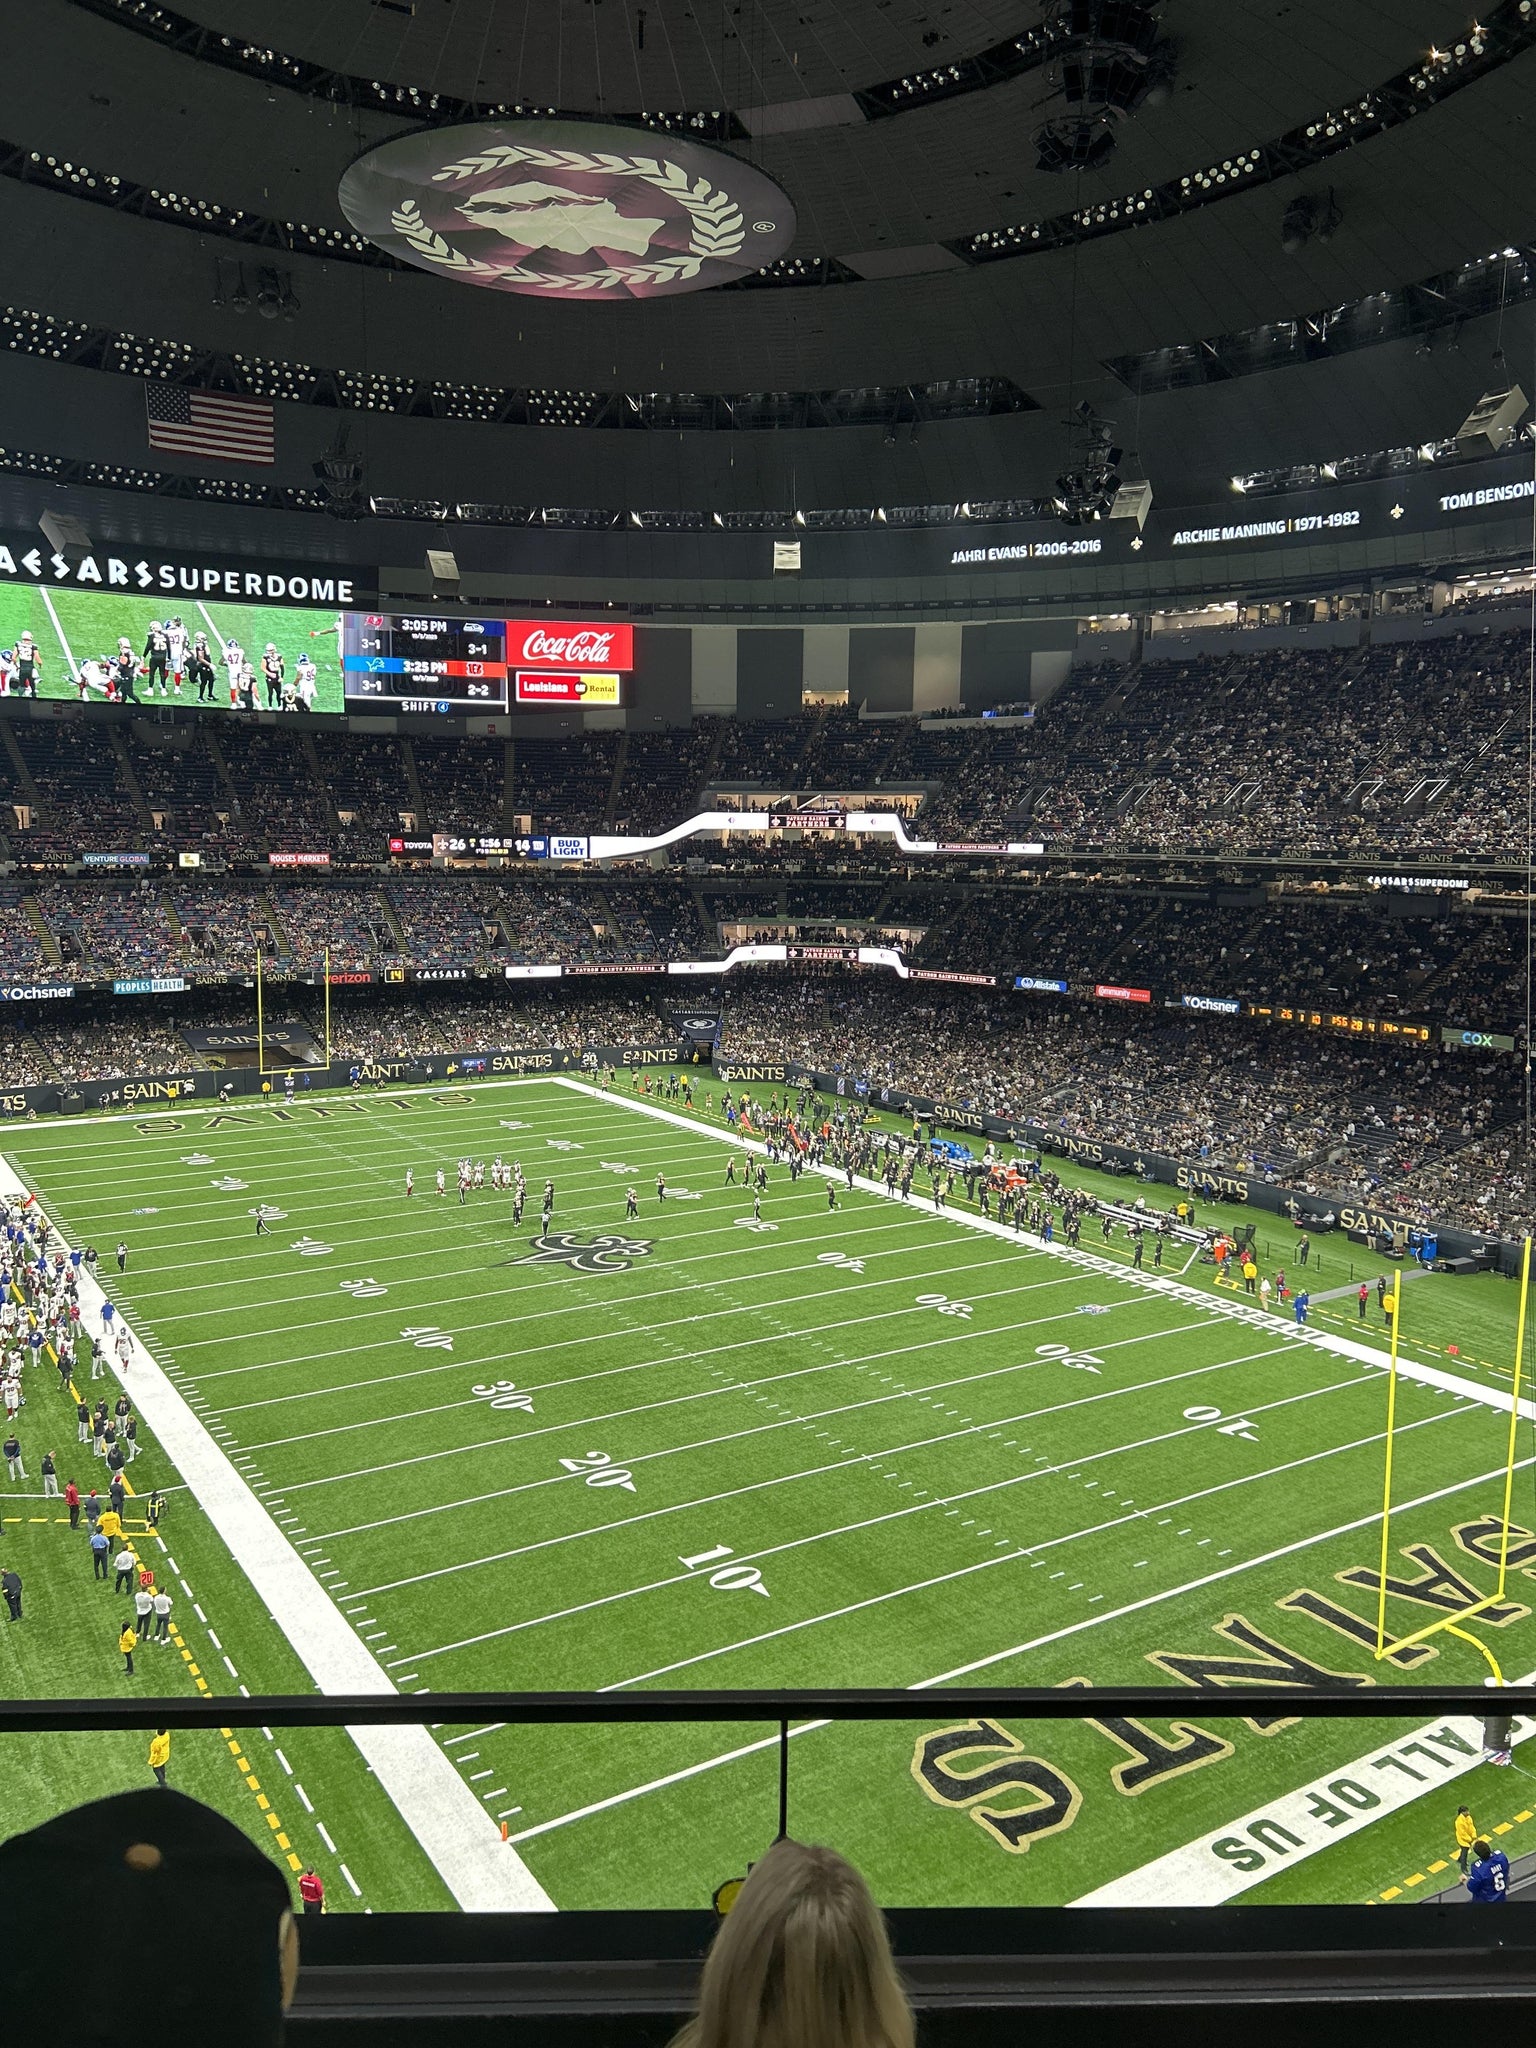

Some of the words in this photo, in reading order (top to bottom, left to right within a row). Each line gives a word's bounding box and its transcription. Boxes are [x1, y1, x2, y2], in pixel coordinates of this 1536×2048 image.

[1440, 493, 1473, 511] TOM
[1476, 481, 1535, 505] BENSON
[1172, 528, 1220, 545] ARCHIE
[1222, 521, 1286, 540] MANNING
[1294, 511, 1360, 531] 1971-1982
[951, 550, 986, 564] JAHRI
[988, 546, 1027, 561] EVANS
[1035, 540, 1101, 556] 2006-2016
[0, 545, 154, 588] AESARS
[159, 565, 354, 603] SUPERDOME
[402, 619, 429, 632] 3:05
[430, 621, 447, 633] PM
[361, 638, 381, 650] 3-1
[468, 643, 487, 655] 3-1
[522, 629, 616, 663] Coca-Cola
[227, 653, 240, 665] 47
[403, 661, 430, 674] 3:25
[430, 662, 448, 674] PM
[362, 680, 382, 692] 3-1
[467, 684, 489, 696] 2-2
[523, 681, 568, 693] Louisiana
[590, 685, 615, 693] Rental
[449, 838, 466, 850] 26
[479, 838, 501, 848] 1:56
[515, 839, 530, 851] 14
[558, 839, 580, 847] BUD
[1048, 845, 1073, 853] SAINTS
[553, 847, 585, 856] LIGHT
[1103, 846, 1129, 854] SAINTS
[1159, 847, 1186, 855] SAINTS
[1219, 849, 1247, 857] SAINTS
[1281, 850, 1311, 858] SAINTS
[1347, 851, 1380, 860] SAINTS
[42, 853, 73, 861] SAINTS
[84, 855, 118, 863] VENTURE
[119, 855, 148, 863] GLOBAL
[230, 853, 259, 861] SAINTS
[270, 854, 296, 863] ROUSES
[781, 858, 806, 866] SAINTS
[836, 859, 860, 867] SAINTS
[1418, 853, 1452, 863] SAINTS
[1494, 855, 1531, 865] SAINTS
[890, 860, 914, 868] SAINTS
[945, 861, 968, 869] SAINTS
[996, 862, 1019, 870] SAINTS
[1101, 866, 1127, 874] SAINTS
[1216, 870, 1244, 878] SAINTS
[1275, 872, 1304, 880] SAINTS
[1367, 876, 1414, 887] CAESARS
[1414, 878, 1469, 889] SUPERDOME
[1471, 880, 1504, 889] SAINTS
[389, 970, 402, 980] 14
[416, 969, 467, 979] CAESARS
[475, 966, 502, 975] SAINTS
[195, 975, 228, 984] SAINTS
[266, 973, 297, 983] SAINTS
[322, 971, 371, 984] verizon
[115, 982, 150, 992] PEOPLES
[152, 979, 183, 991] HEALTH
[1033, 980, 1061, 991] Allstate
[1070, 983, 1094, 993] SAINTS
[10, 986, 73, 1000] Ochsner
[1098, 985, 1131, 999] Community
[1191, 996, 1238, 1013] Ochsner
[1281, 1008, 1293, 1019] 26
[206, 1031, 290, 1045] SAINTS
[1462, 1031, 1492, 1047] COX
[492, 1053, 552, 1071] SAINTS
[623, 1049, 677, 1064] SAINTS
[350, 1063, 409, 1080] AINT
[727, 1066, 785, 1080] SAINTS
[124, 1078, 195, 1100] SAINTS
[133, 1094, 475, 1135] SAINTS
[934, 1105, 983, 1128] SAINTS
[1044, 1133, 1103, 1160] SAINTS
[1177, 1167, 1248, 1200] SAINTS
[733, 1218, 779, 1233] 50
[816, 1252, 867, 1269] 40
[339, 1277, 388, 1297] 50
[915, 1294, 974, 1315] 30
[1161, 1285, 1326, 1341] INTERCEPT
[400, 1326, 454, 1349] 40
[1035, 1344, 1106, 1369] 20
[471, 1380, 533, 1410] 30
[1183, 1406, 1260, 1437] 10
[558, 1451, 632, 1488] 20
[678, 1544, 762, 1590] 10
[141, 1573, 152, 1585] 20
[910, 1514, 1536, 1854] SAINTS
[1370, 1726, 1478, 1783] ALL
[1307, 1778, 1382, 1829] OF
[1211, 1818, 1307, 1873] US
[1494, 1872, 1506, 1891] 6
